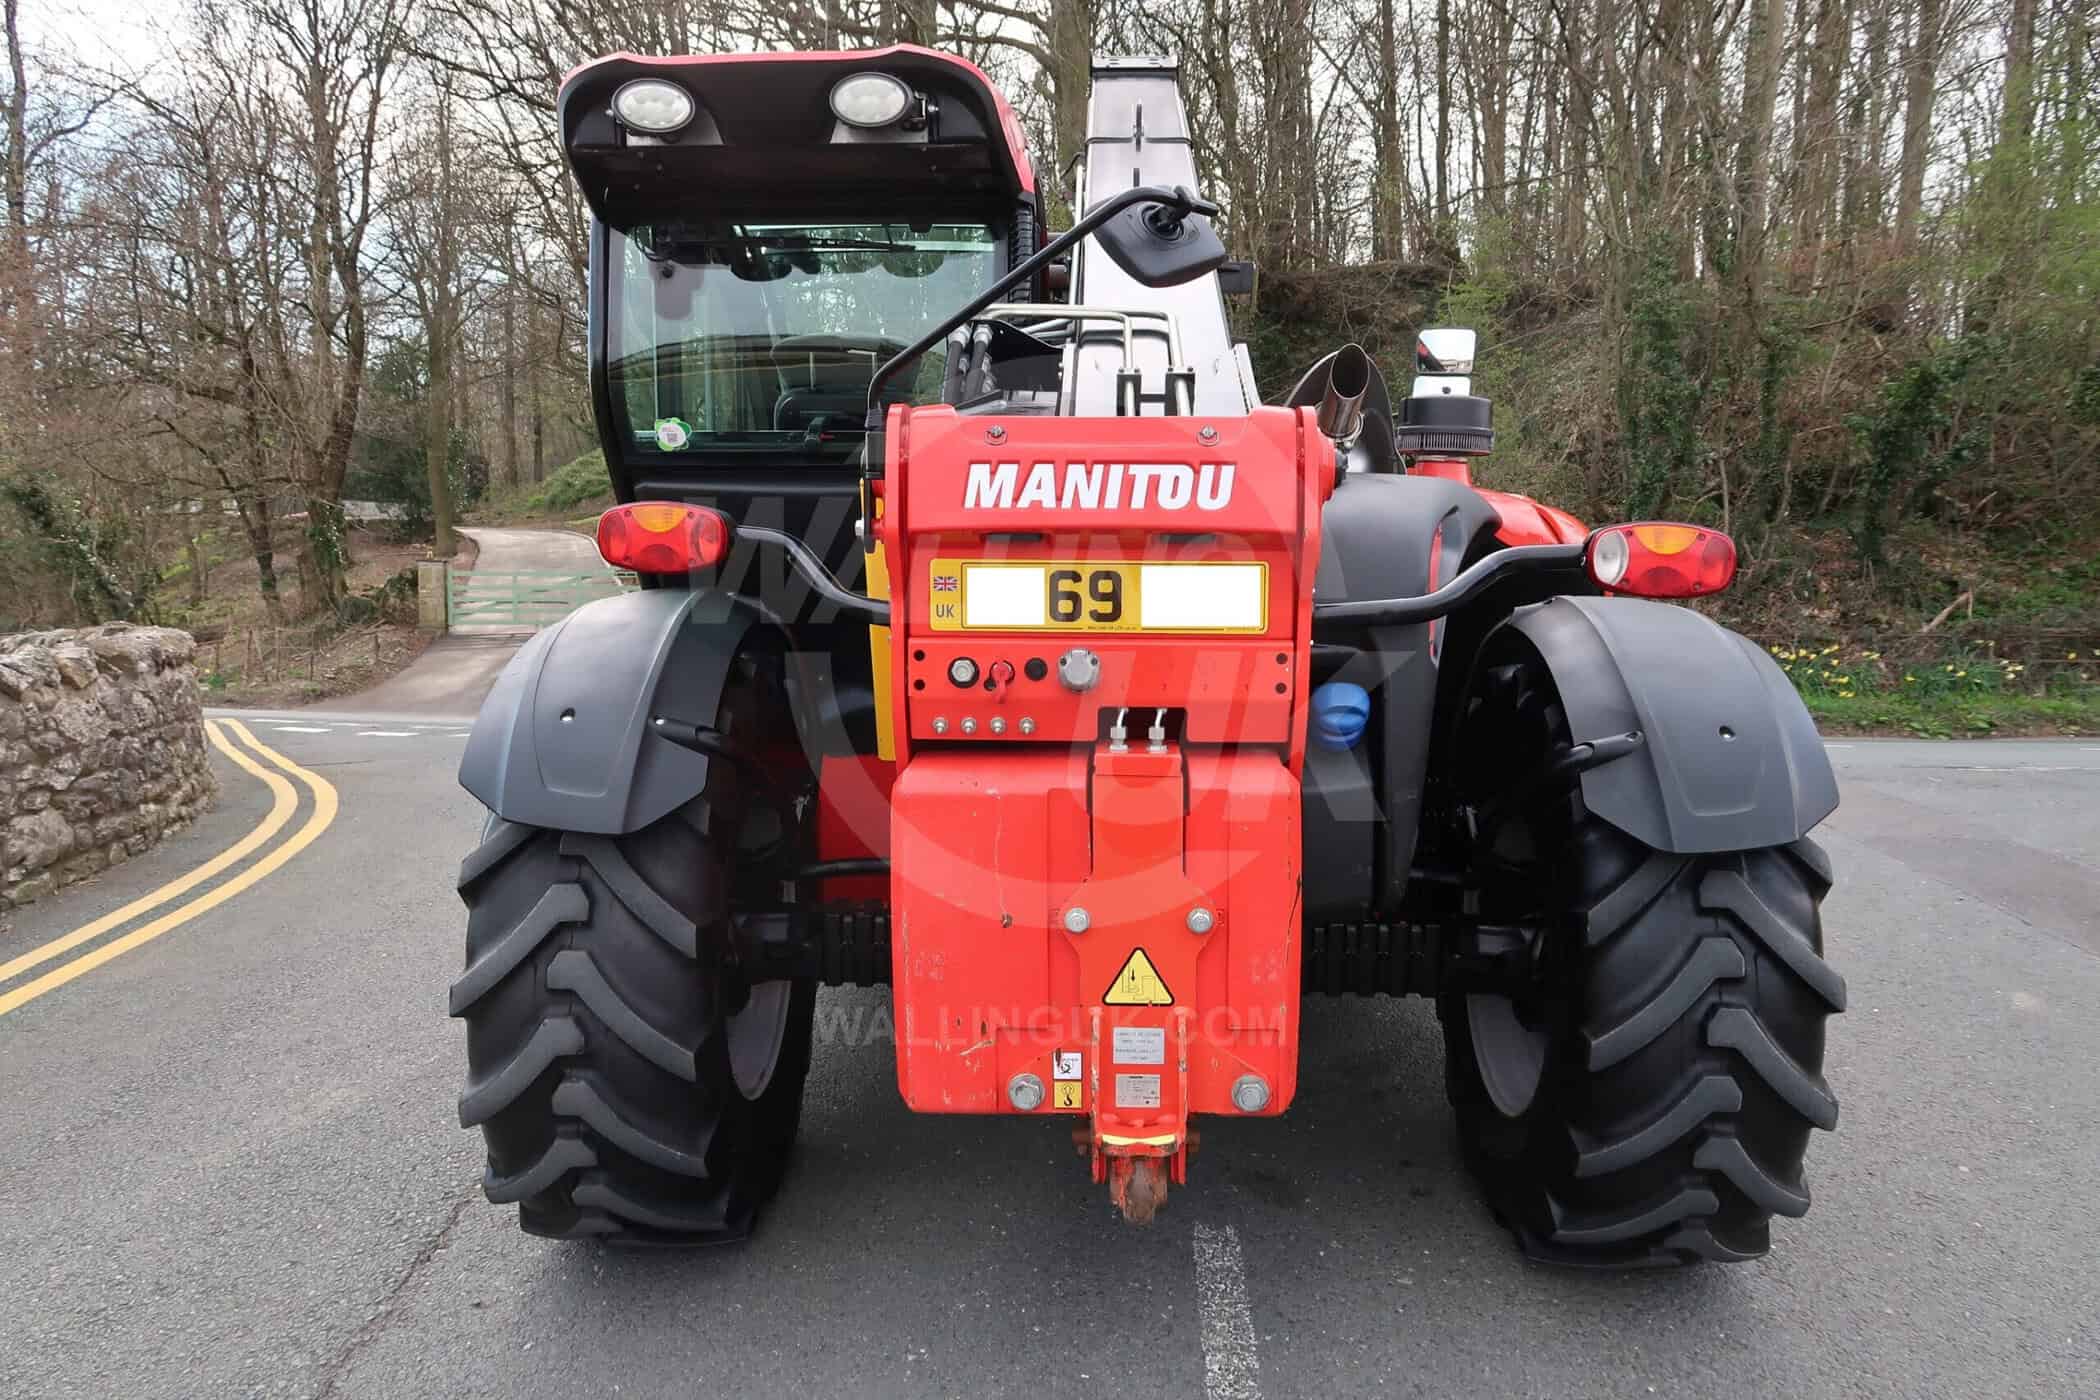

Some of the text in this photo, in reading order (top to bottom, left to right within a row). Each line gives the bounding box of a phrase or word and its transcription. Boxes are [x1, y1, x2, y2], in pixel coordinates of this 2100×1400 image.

[963, 463, 1236, 511] MANITOU
[936, 604, 954, 618] UK
[1048, 570, 1123, 623] 69
